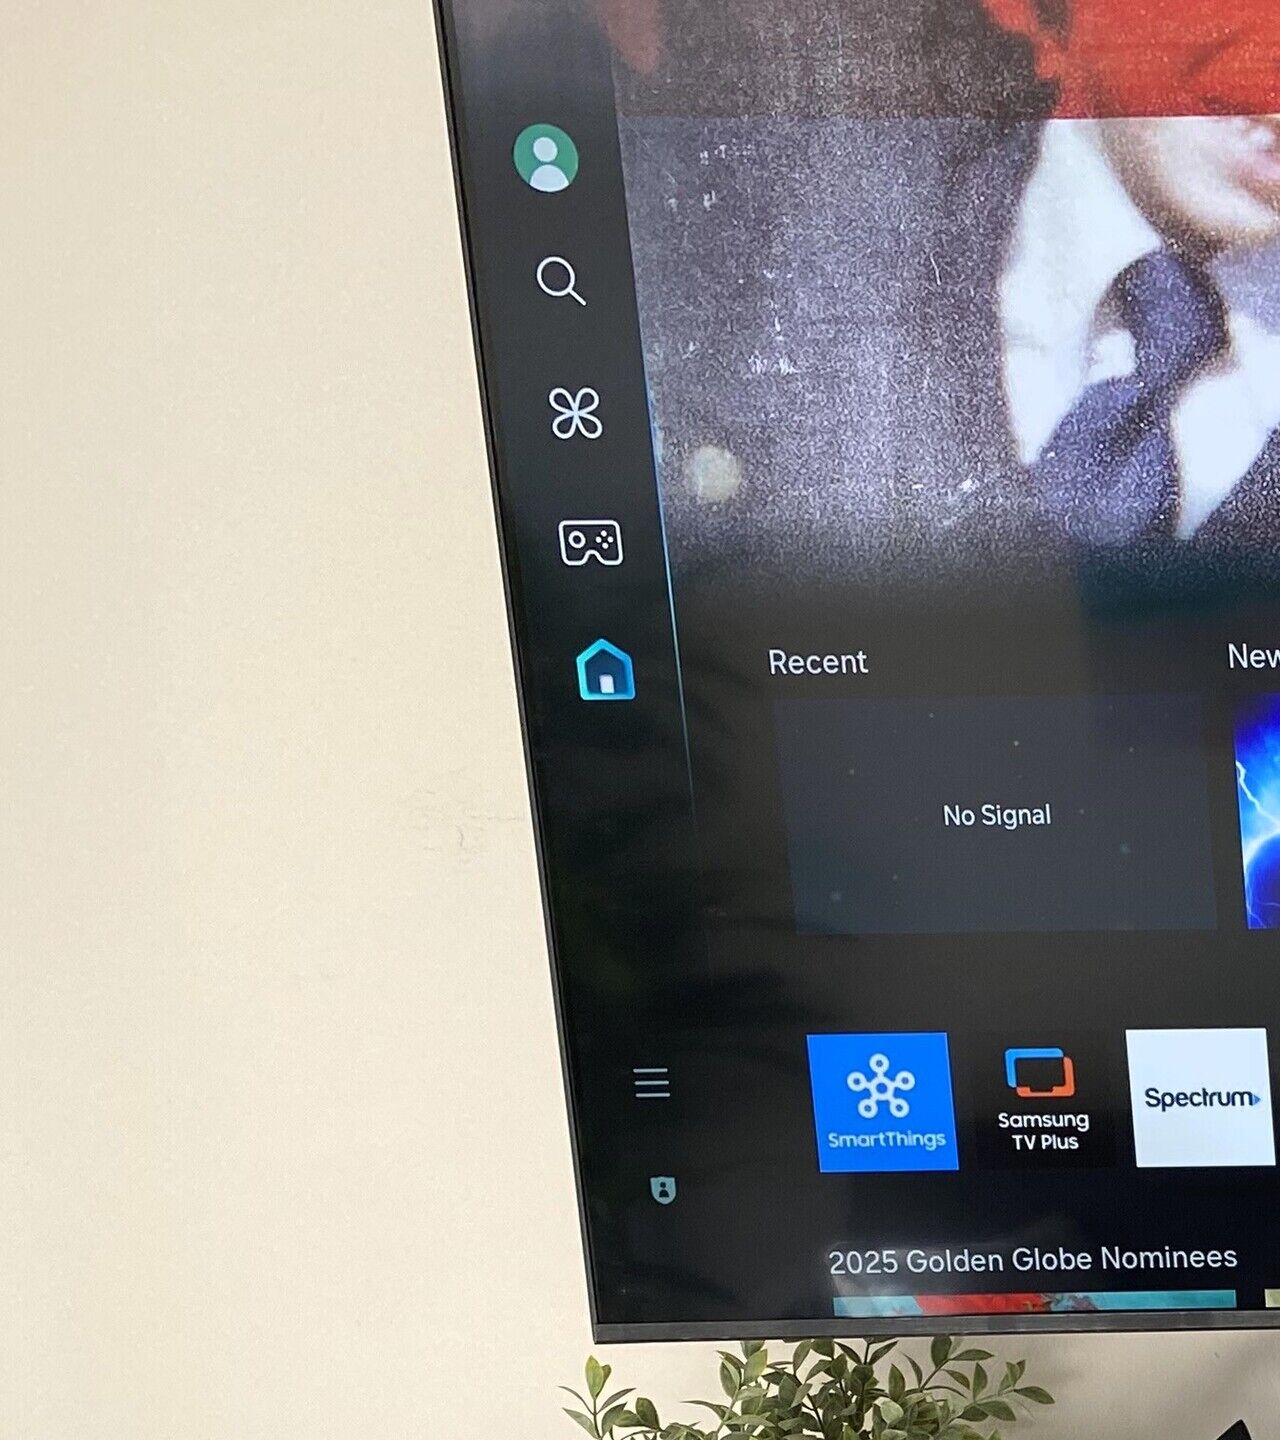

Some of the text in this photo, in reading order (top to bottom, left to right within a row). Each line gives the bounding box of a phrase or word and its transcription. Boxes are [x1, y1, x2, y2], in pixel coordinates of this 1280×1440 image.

[769, 649, 868, 675] Recent
[943, 803, 1051, 830] No Signal
[1144, 1087, 1255, 1111] Spectrum
[998, 1112, 1090, 1132] Samsung
[828, 1131, 947, 1150] SmartThings
[1011, 1134, 1079, 1151] TV Plus
[828, 1246, 1238, 1275] 2025 Golden Globe Nominees
